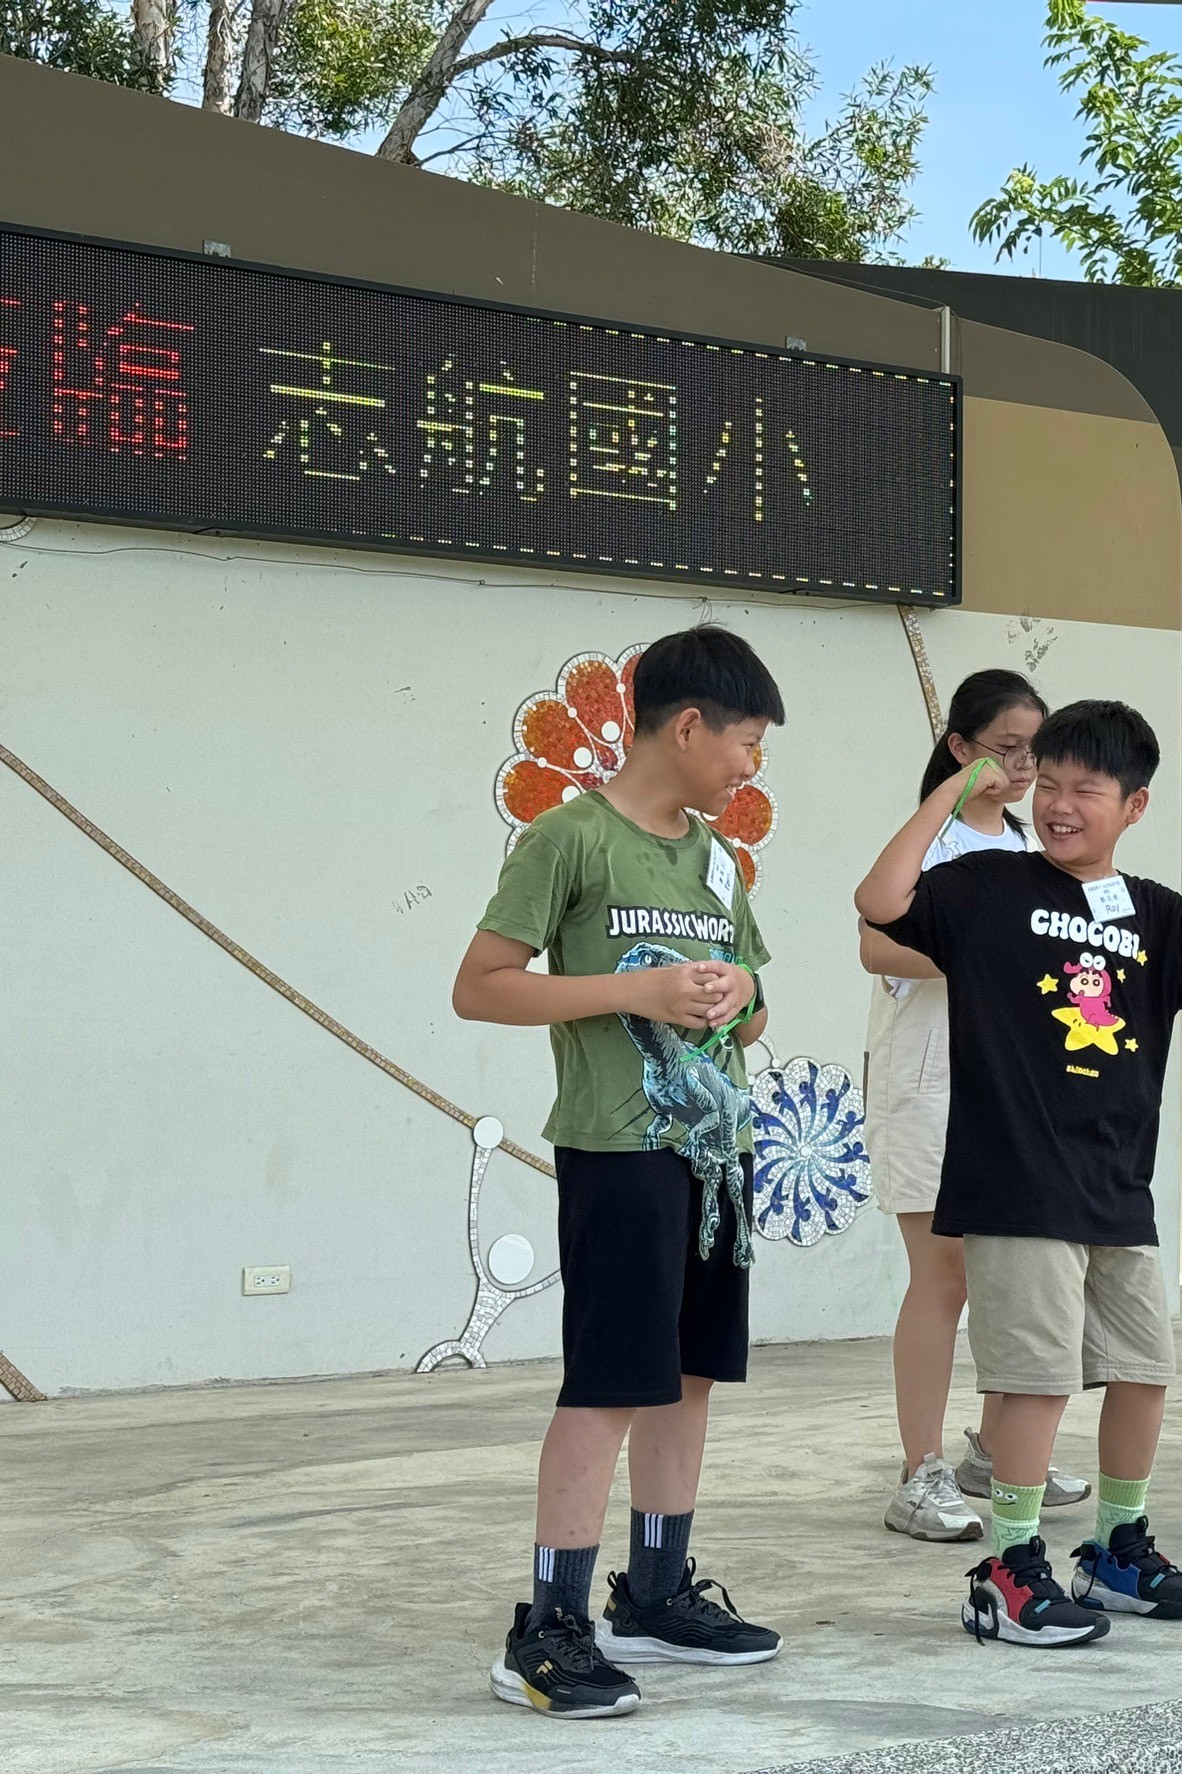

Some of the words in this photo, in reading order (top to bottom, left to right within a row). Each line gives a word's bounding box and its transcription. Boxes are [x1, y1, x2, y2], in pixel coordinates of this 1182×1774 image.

[0, 299, 195, 461] 臨
[259, 342, 812, 522] 志航國小
[1030, 908, 1140, 960] CHOCOBI
